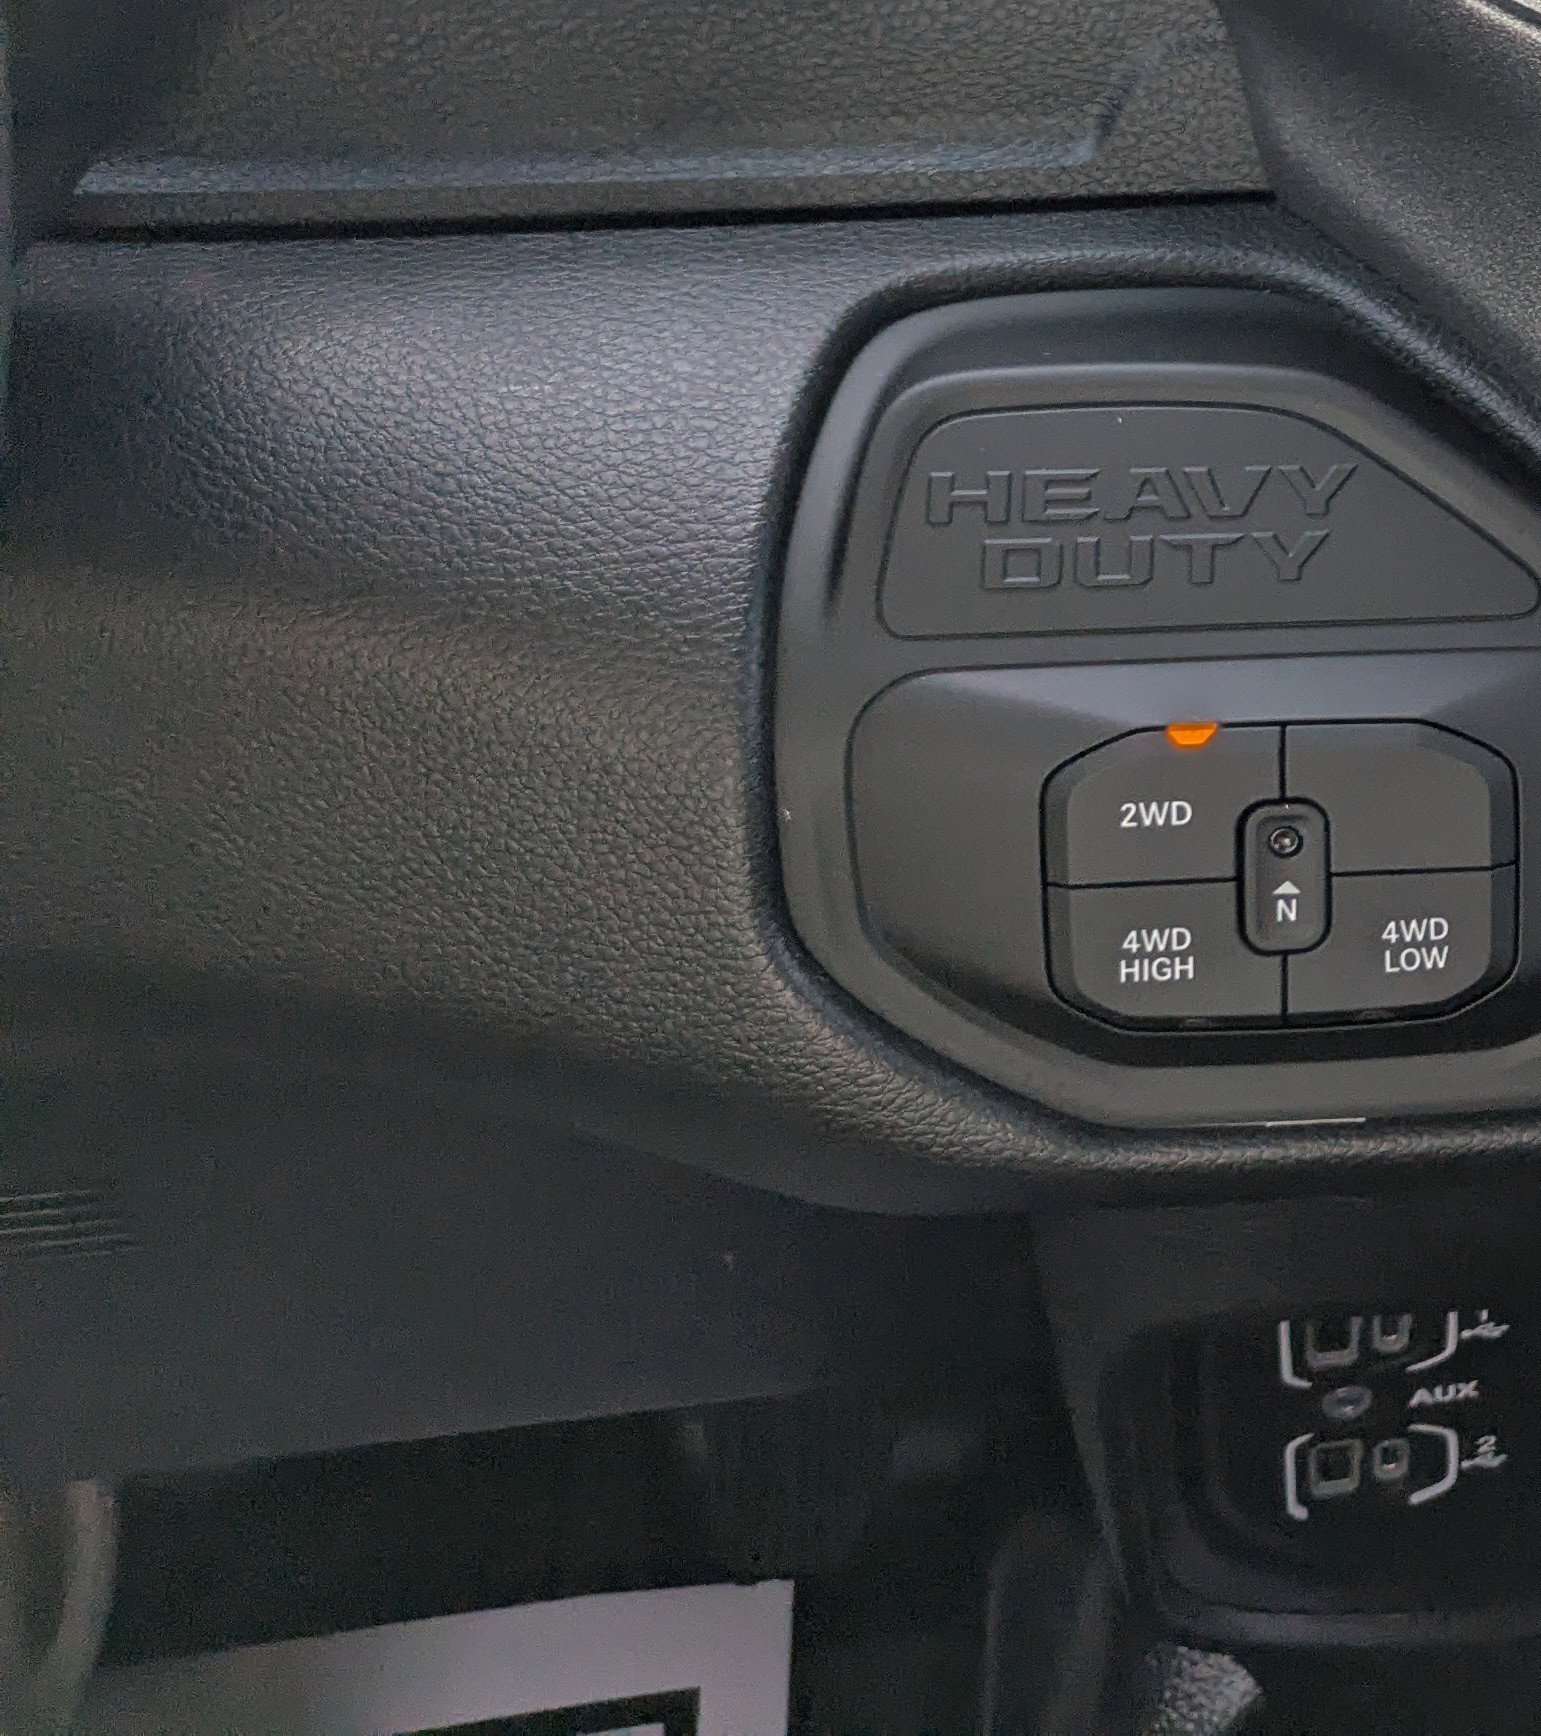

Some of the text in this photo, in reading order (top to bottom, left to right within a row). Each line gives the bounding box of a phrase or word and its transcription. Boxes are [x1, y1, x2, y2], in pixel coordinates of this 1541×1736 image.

[926, 463, 1359, 526] HEAVY
[980, 529, 1330, 591] DUTY
[1119, 800, 1193, 829] 2WD
[1276, 898, 1298, 922] N
[1122, 927, 1192, 954] 4WD
[1381, 917, 1449, 944] 4WD
[1119, 955, 1195, 983] HIGH
[1384, 945, 1449, 973] LOW
[1408, 1380, 1481, 1408] AUX
